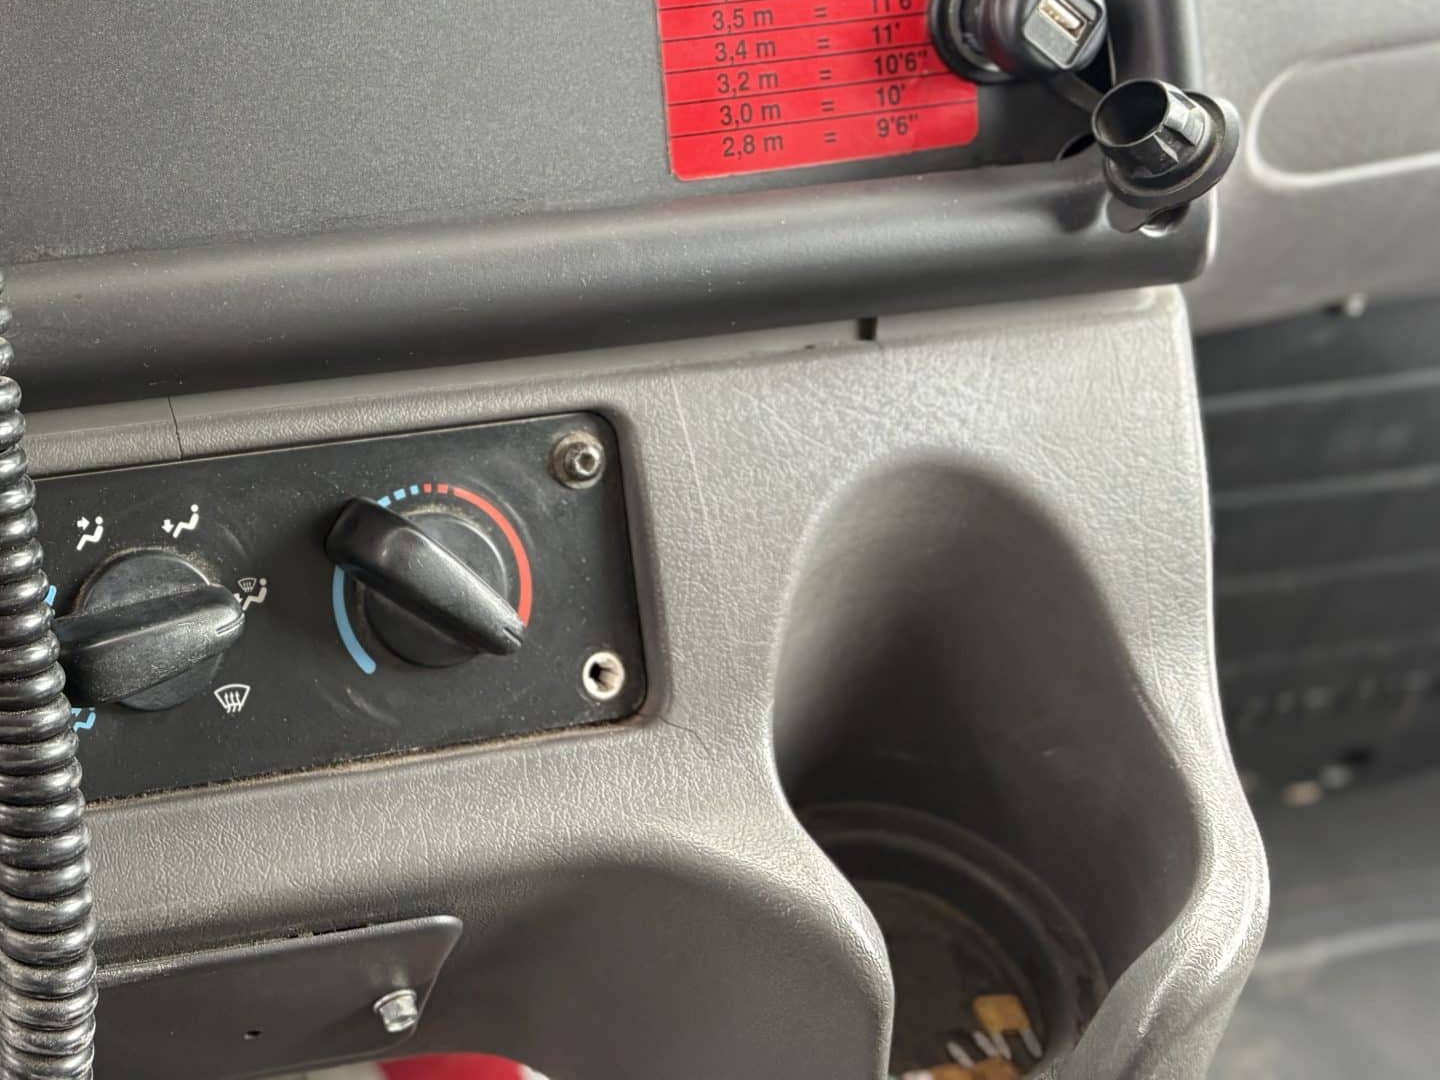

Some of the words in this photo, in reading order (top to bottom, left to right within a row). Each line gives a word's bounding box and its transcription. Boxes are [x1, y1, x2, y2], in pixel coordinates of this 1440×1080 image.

[712, 8, 745, 35] 3,5
[753, 10, 774, 27] m
[714, 40, 747, 67] 3,4
[756, 41, 776, 58] m
[871, 22, 901, 44] 11'
[717, 71, 750, 97] 3,2
[758, 73, 778, 89] m
[873, 50, 928, 75] 10'6"
[720, 103, 753, 130] 3,0
[762, 104, 782, 121] m
[875, 83, 906, 106] 10'
[722, 135, 755, 161] 2,8
[764, 136, 784, 152] m
[876, 114, 919, 137] 9'6"
